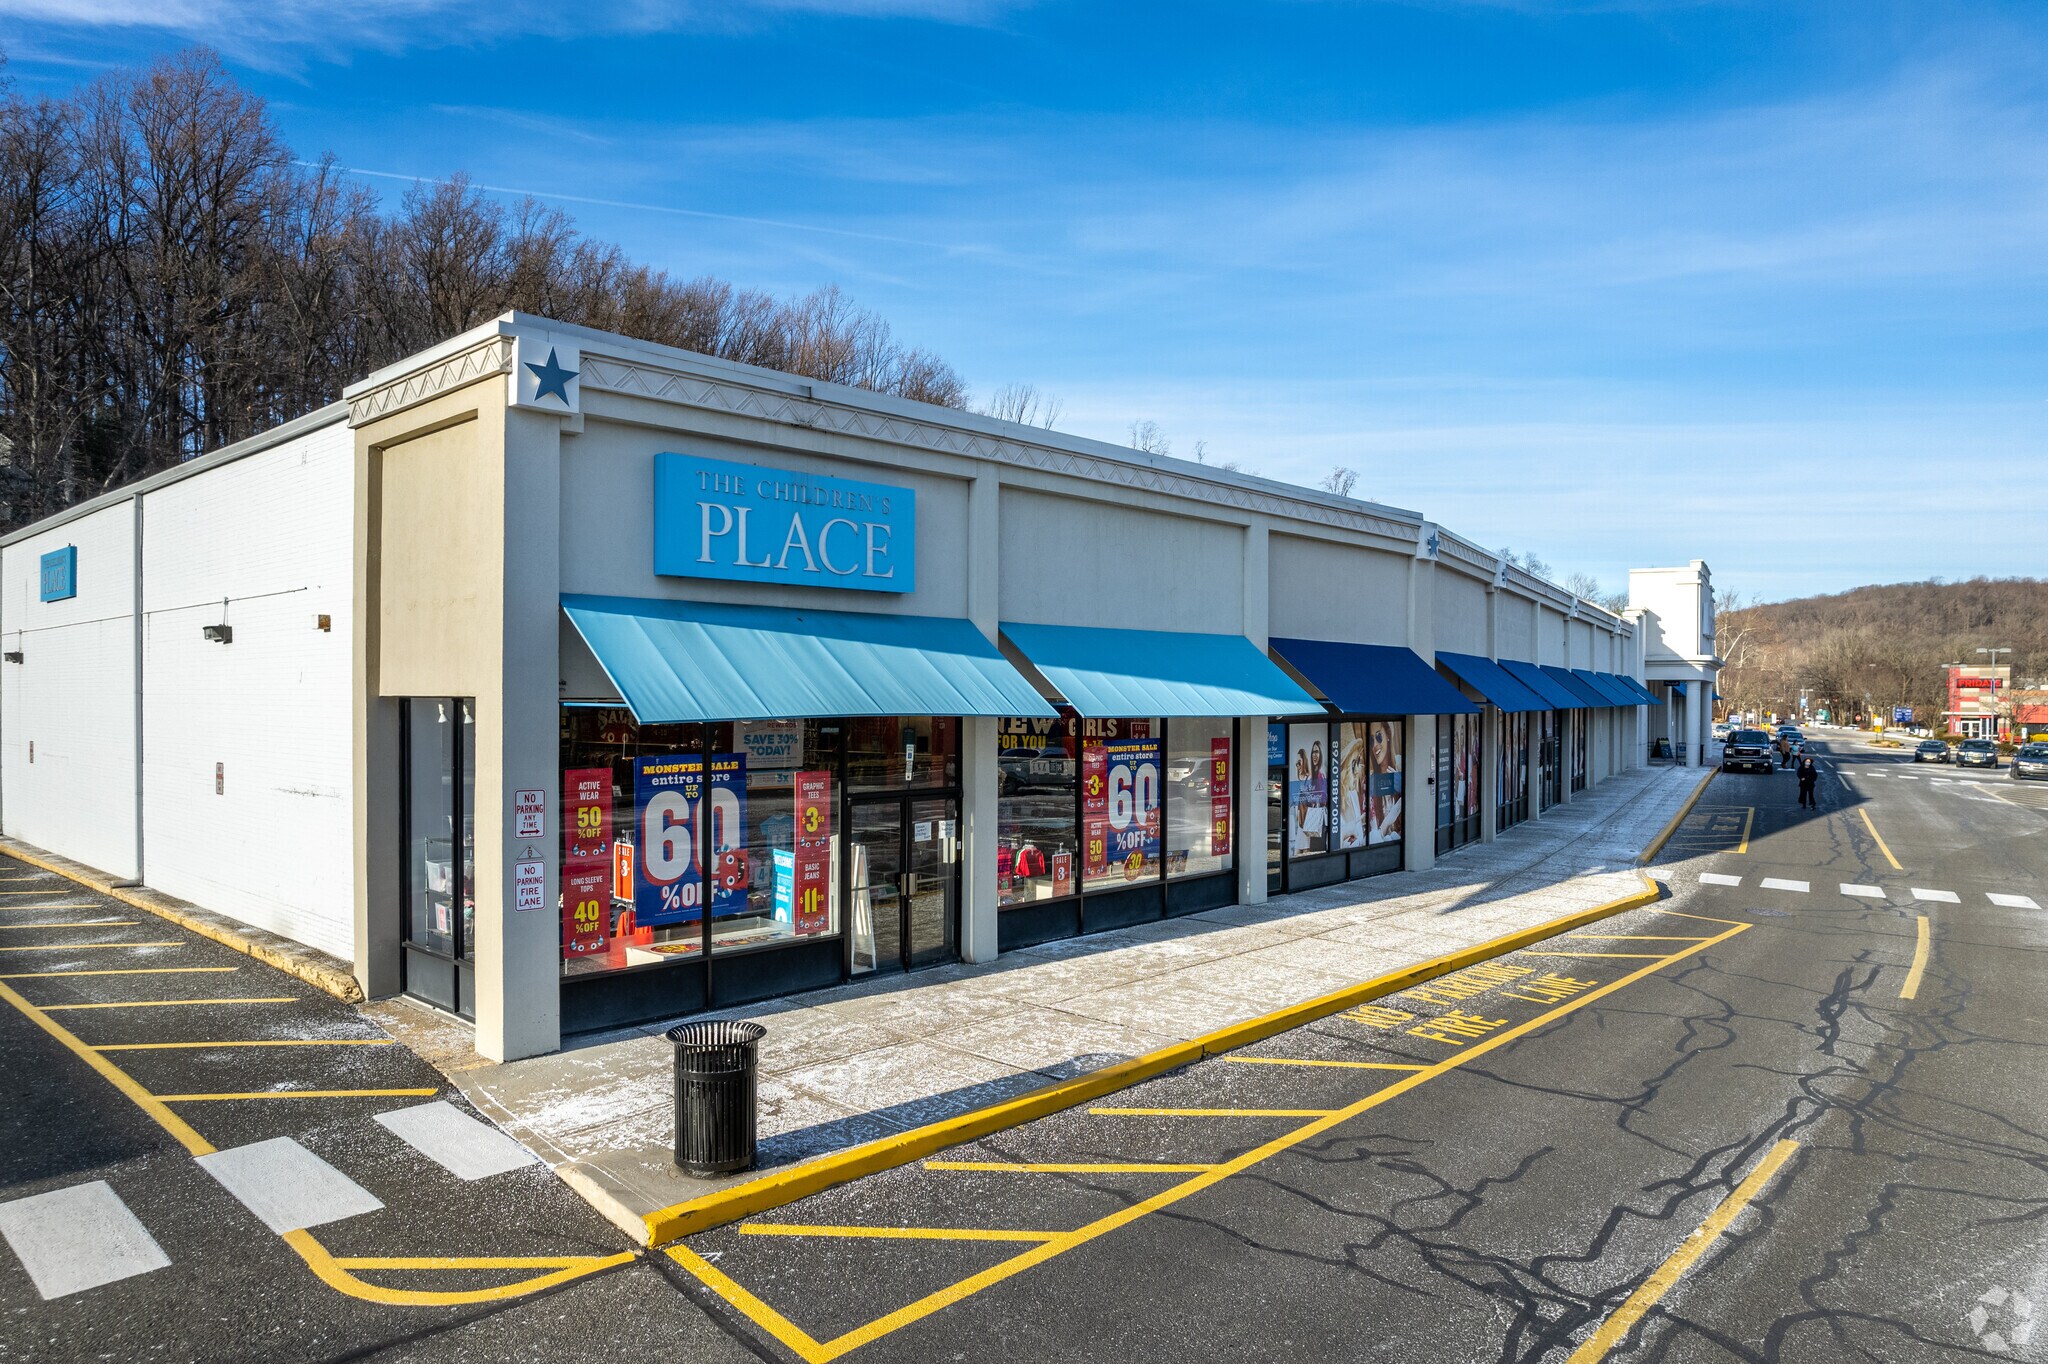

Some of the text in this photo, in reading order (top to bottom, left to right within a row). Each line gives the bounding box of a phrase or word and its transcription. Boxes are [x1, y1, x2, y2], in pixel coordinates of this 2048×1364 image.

[696, 471, 892, 515] THE CHILDREN'S
[696, 501, 895, 578] PLACE
[743, 734, 775, 745] SAVE
[777, 734, 798, 744] 30%
[1022, 735, 1046, 750] YOU
[749, 745, 790, 756] TODAY!
[1108, 745, 1140, 753] MONSTER
[1112, 752, 1134, 761] entire
[643, 763, 702, 774] MONSTER
[1215, 761, 1226, 775] 50
[652, 773, 730, 786] entire sore
[578, 782, 600, 790] ACTIVE
[802, 782, 824, 791] GRAPHIC
[524, 794, 536, 803] NO
[579, 791, 599, 800] WEAR
[807, 790, 819, 799] TEES
[1108, 763, 1158, 829] 60
[517, 804, 543, 814] PARKING
[577, 806, 602, 828] 50
[1216, 820, 1227, 834] 60
[577, 828, 601, 839] %OFF
[642, 787, 740, 882] 60
[1116, 830, 1147, 851] %OFF
[1089, 839, 1103, 855] 50
[804, 863, 820, 871] BASIC
[1128, 853, 1143, 870] 30
[524, 867, 536, 875] NO
[804, 871, 820, 880] JEANS
[517, 876, 543, 886] PARKING
[571, 876, 603, 886] LONG SLEEVE
[521, 887, 539, 896] FIRE
[580, 885, 594, 893] TOPS
[519, 897, 541, 907] LANE
[573, 899, 600, 922] 40
[575, 921, 599, 934] %OFF
[1338, 962, 1534, 1030] NO PARKING
[1405, 972, 1599, 1046] FIRE LANE
